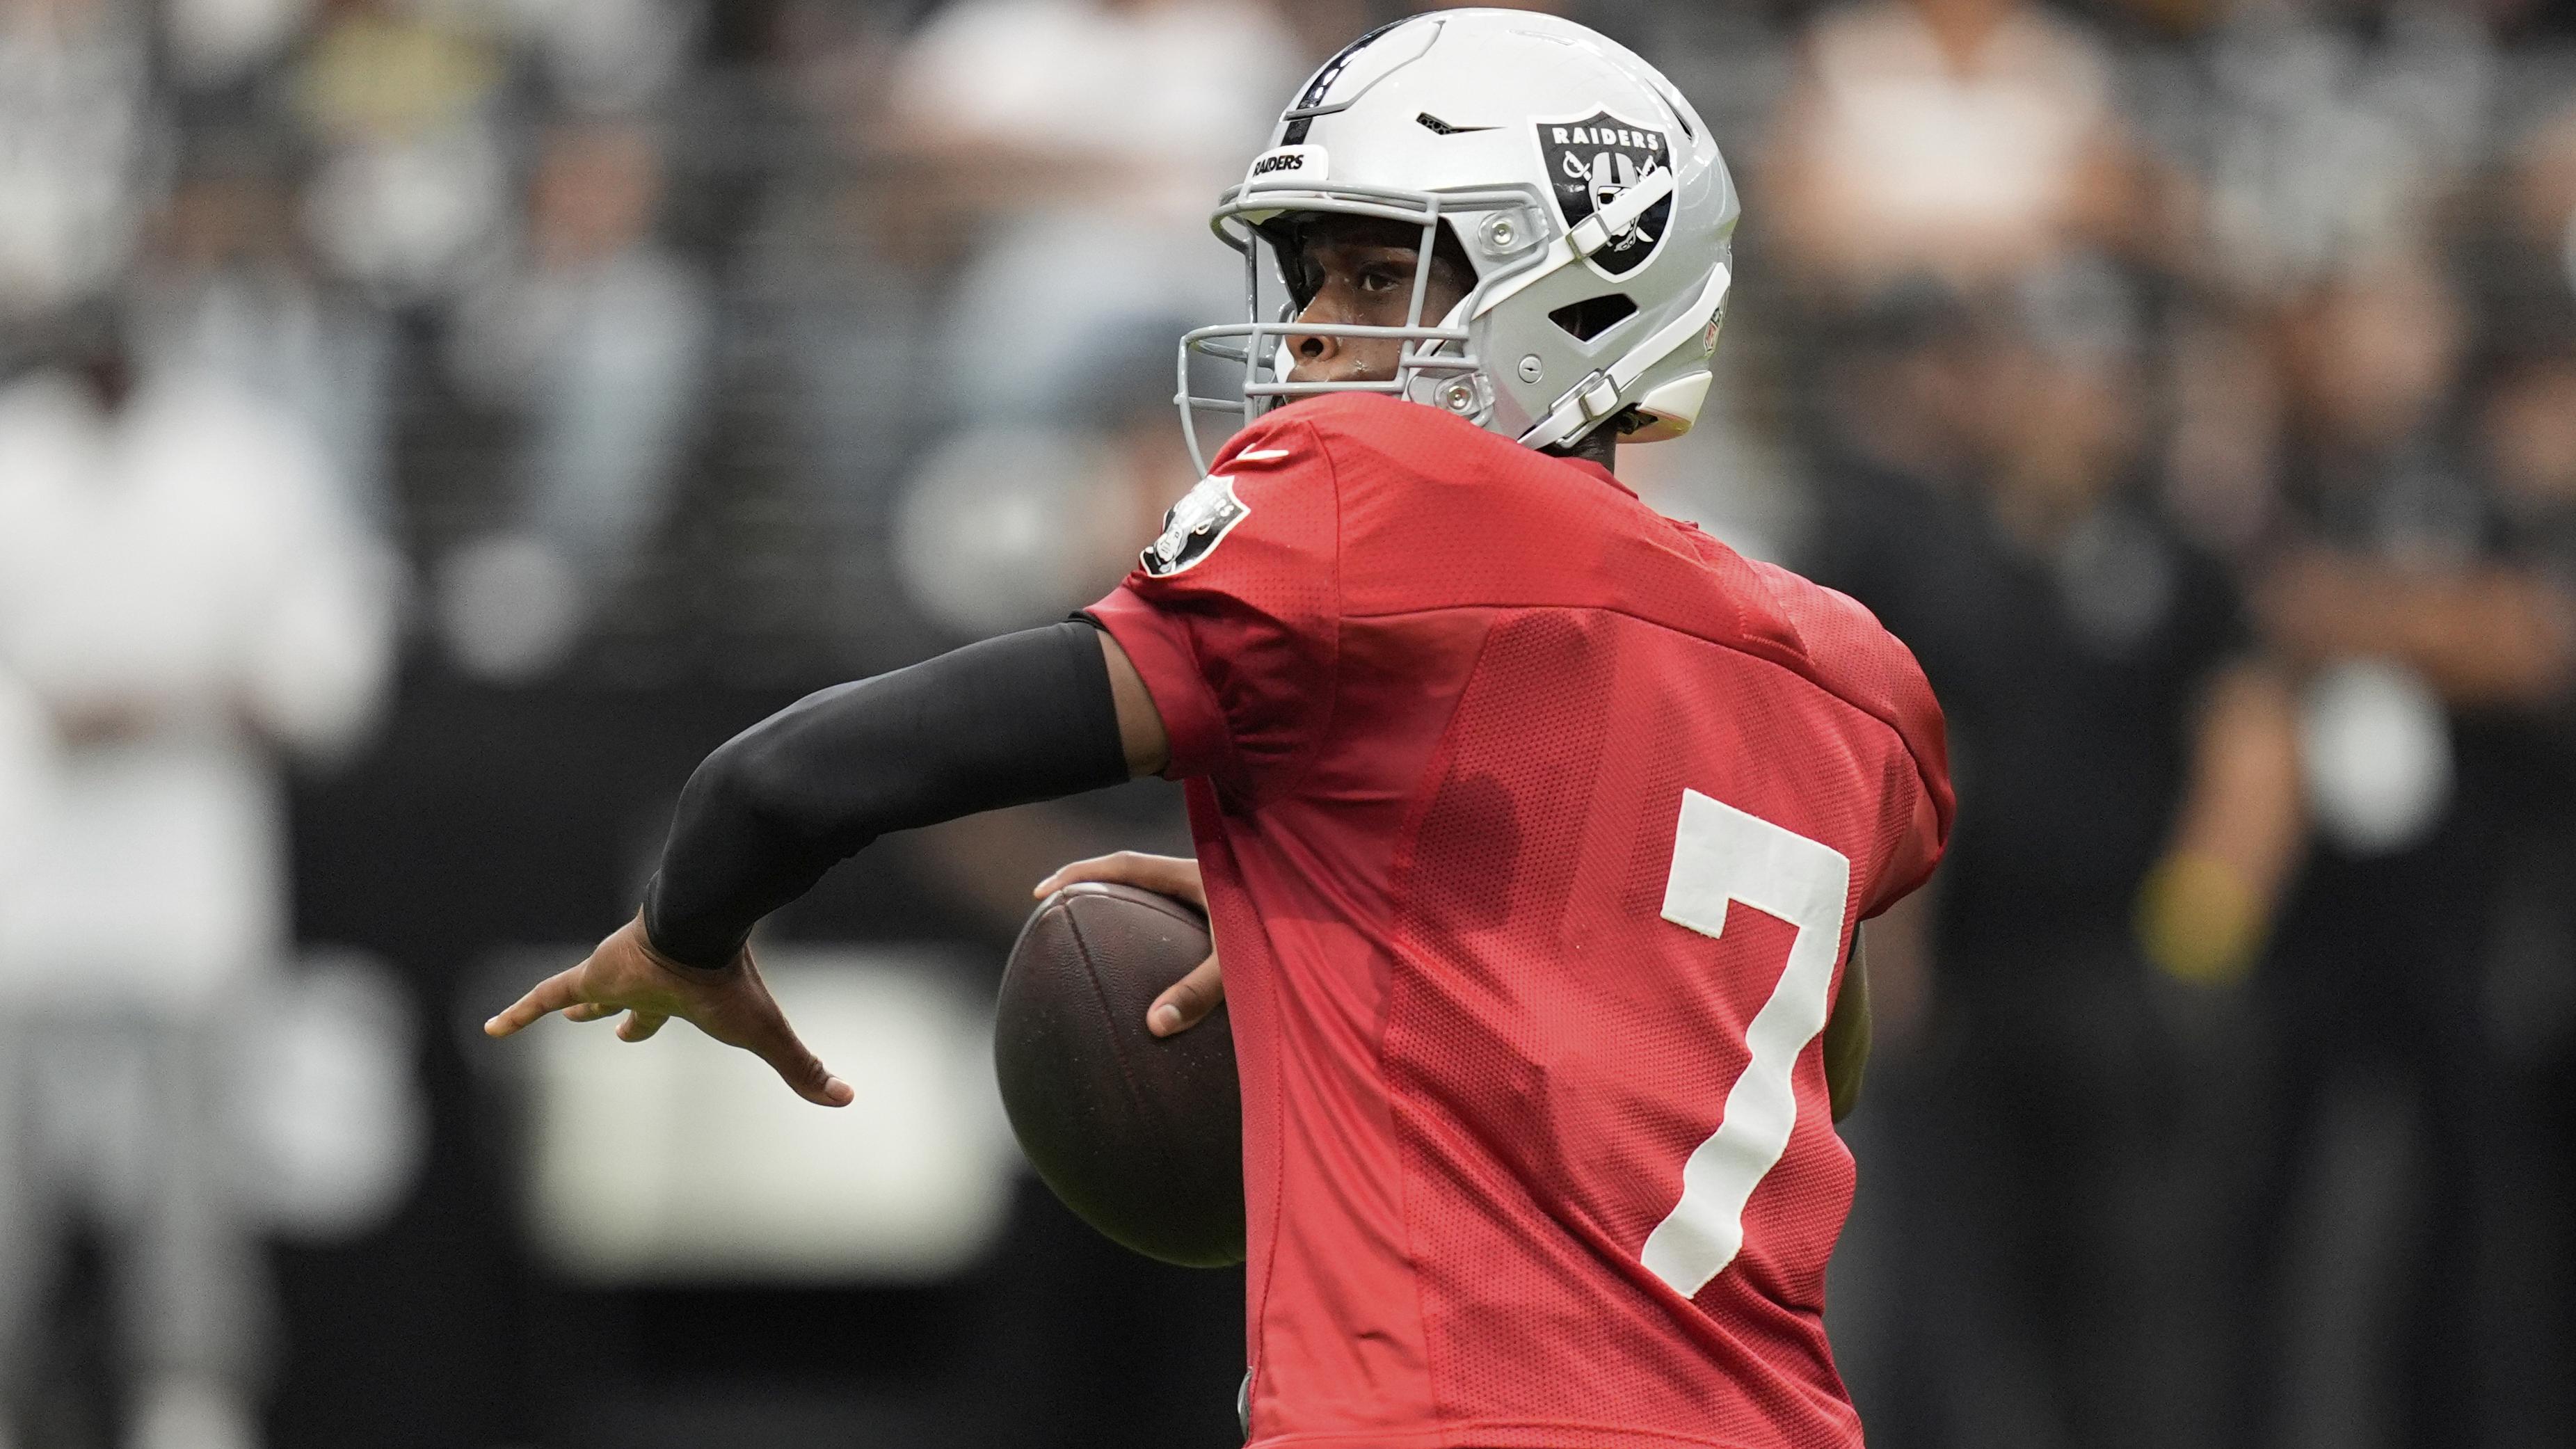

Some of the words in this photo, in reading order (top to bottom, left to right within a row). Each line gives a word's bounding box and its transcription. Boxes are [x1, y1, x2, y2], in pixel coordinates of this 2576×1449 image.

[1552, 127, 1659, 150] RAIDERS
[1253, 154, 1304, 177] RAIDERS
[1641, 787, 1850, 1298] 7
